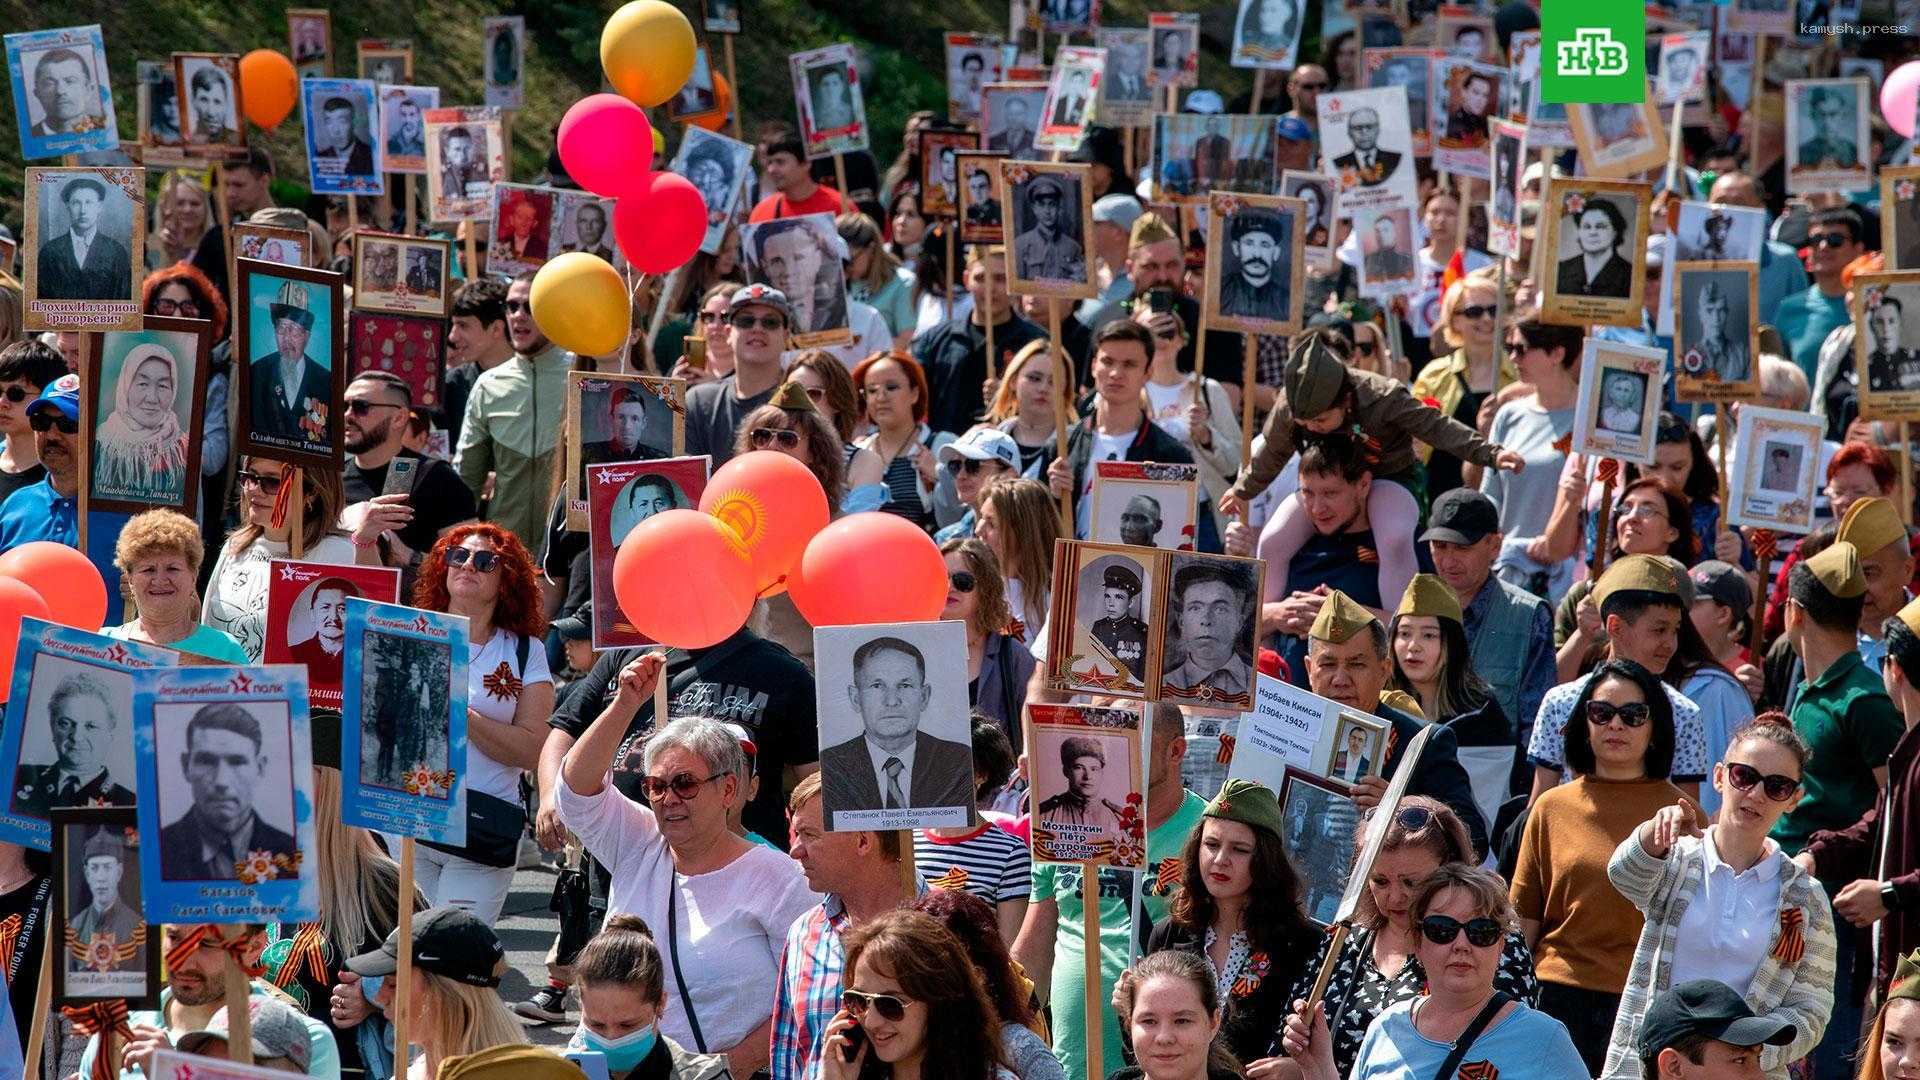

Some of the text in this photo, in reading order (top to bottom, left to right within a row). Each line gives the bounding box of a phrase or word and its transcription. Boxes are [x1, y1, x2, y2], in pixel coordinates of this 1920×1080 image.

[31, 301, 138, 314] Плохих Илларион
[46, 313, 122, 325] Григорьевич
[1258, 687, 1322, 719] Нарбаев Кимсан
[842, 809, 959, 820] Степанюк Павел Емельянович
[1042, 821, 1103, 833] Мохнаткин
[1046, 841, 1101, 853] Петрович
[35, 878, 52, 901] OUNG
[17, 907, 40, 948] FOREVER
